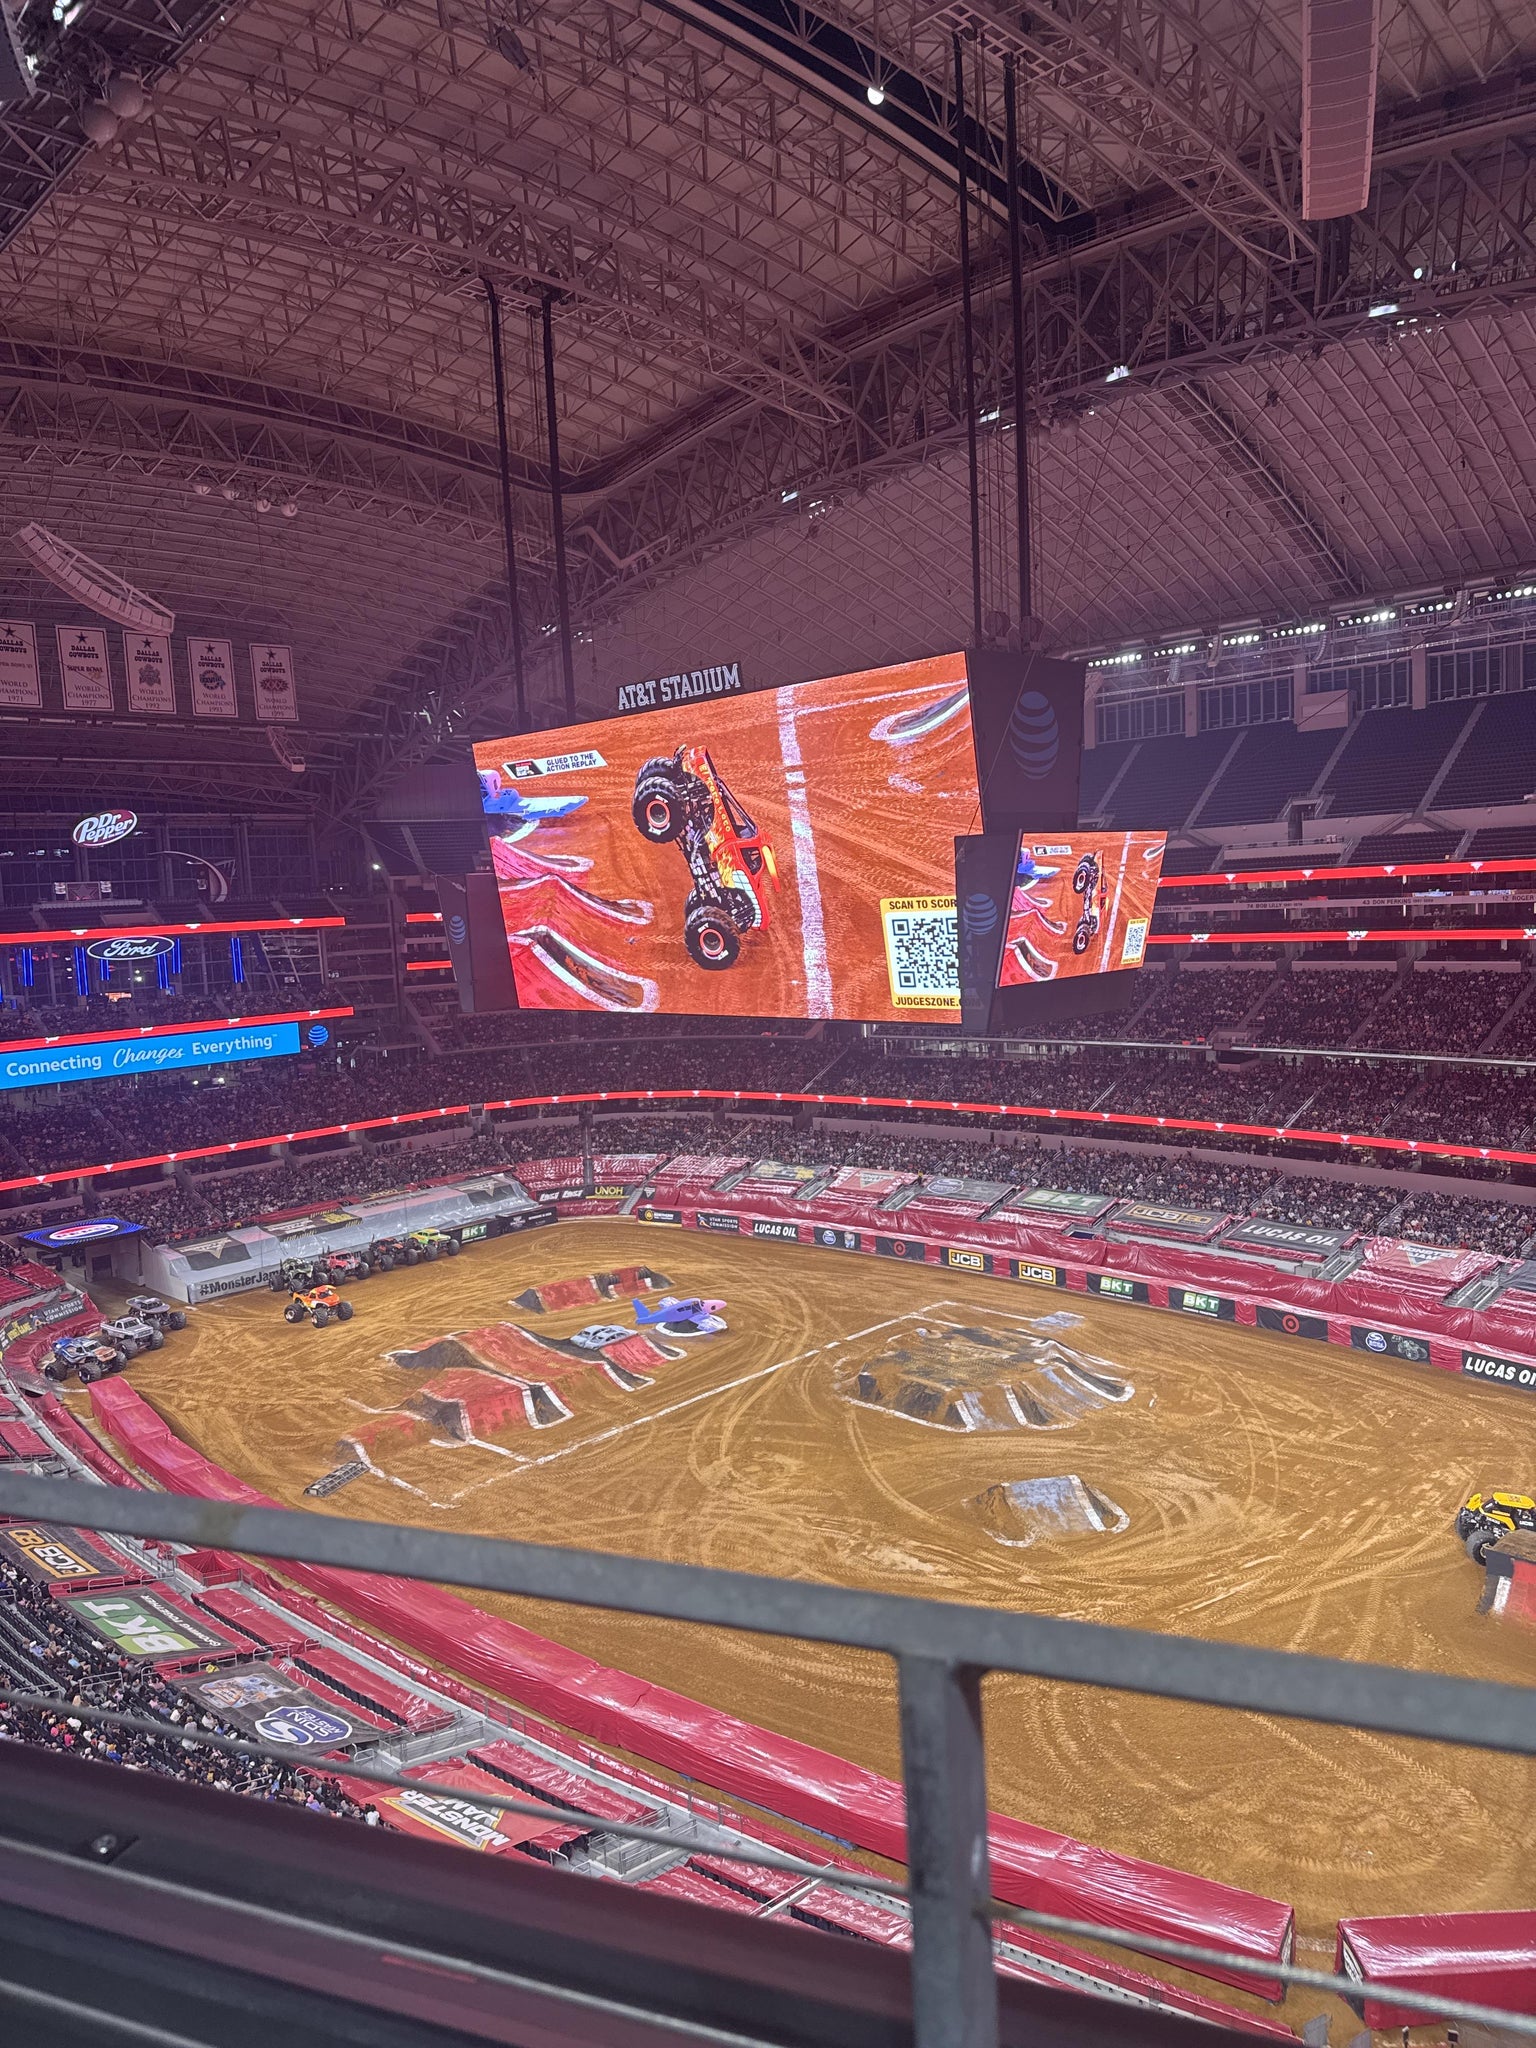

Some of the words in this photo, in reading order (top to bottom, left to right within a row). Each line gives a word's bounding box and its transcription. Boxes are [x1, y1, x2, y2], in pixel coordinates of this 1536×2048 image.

[69, 651, 99, 659] COWBOYS
[74, 684, 101, 692] WORLD
[618, 680, 657, 711] AT&T
[660, 663, 742, 702] STADIUM
[67, 692, 110, 700] CHAMPIONS
[546, 757, 568, 766] GLUED
[580, 752, 594, 760] THE
[546, 763, 571, 772] ACTION
[571, 759, 597, 768] REPLAY
[97, 813, 122, 829] Dr
[77, 817, 134, 844] Pepper
[889, 900, 914, 910] SCAN
[916, 899, 929, 909] TO
[103, 939, 160, 957] Ford
[895, 996, 961, 1007] JUDGESZONE.
[6, 1053, 102, 1078] Connecting
[112, 1047, 186, 1069] Changes
[594, 1185, 624, 1196] UNOH
[1028, 1191, 1103, 1207] BKT
[1133, 1207, 1181, 1220] JCB
[461, 1224, 487, 1239] BKT
[754, 1223, 781, 1235] LUCAS
[782, 1226, 798, 1237] OIL
[1242, 1224, 1307, 1241] LUCAS
[1304, 1234, 1340, 1247] OIL
[1395, 1244, 1459, 1259] MONSTER
[951, 1252, 982, 1268] JCB
[1021, 1266, 1053, 1281] JCB
[1100, 1276, 1133, 1293] BKT
[43, 1306, 60, 1317] UTAH
[59, 1300, 83, 1313] SPORTS
[1183, 1292, 1219, 1311] BKT
[45, 1305, 84, 1322] COMMISSION
[1465, 1356, 1517, 1381] LUCAS
[1518, 1369, 1536, 1387] OI
[33, 1545, 87, 1574] JCB
[82, 1600, 187, 1653] BKT
[400, 1789, 512, 1847] MONSTER
